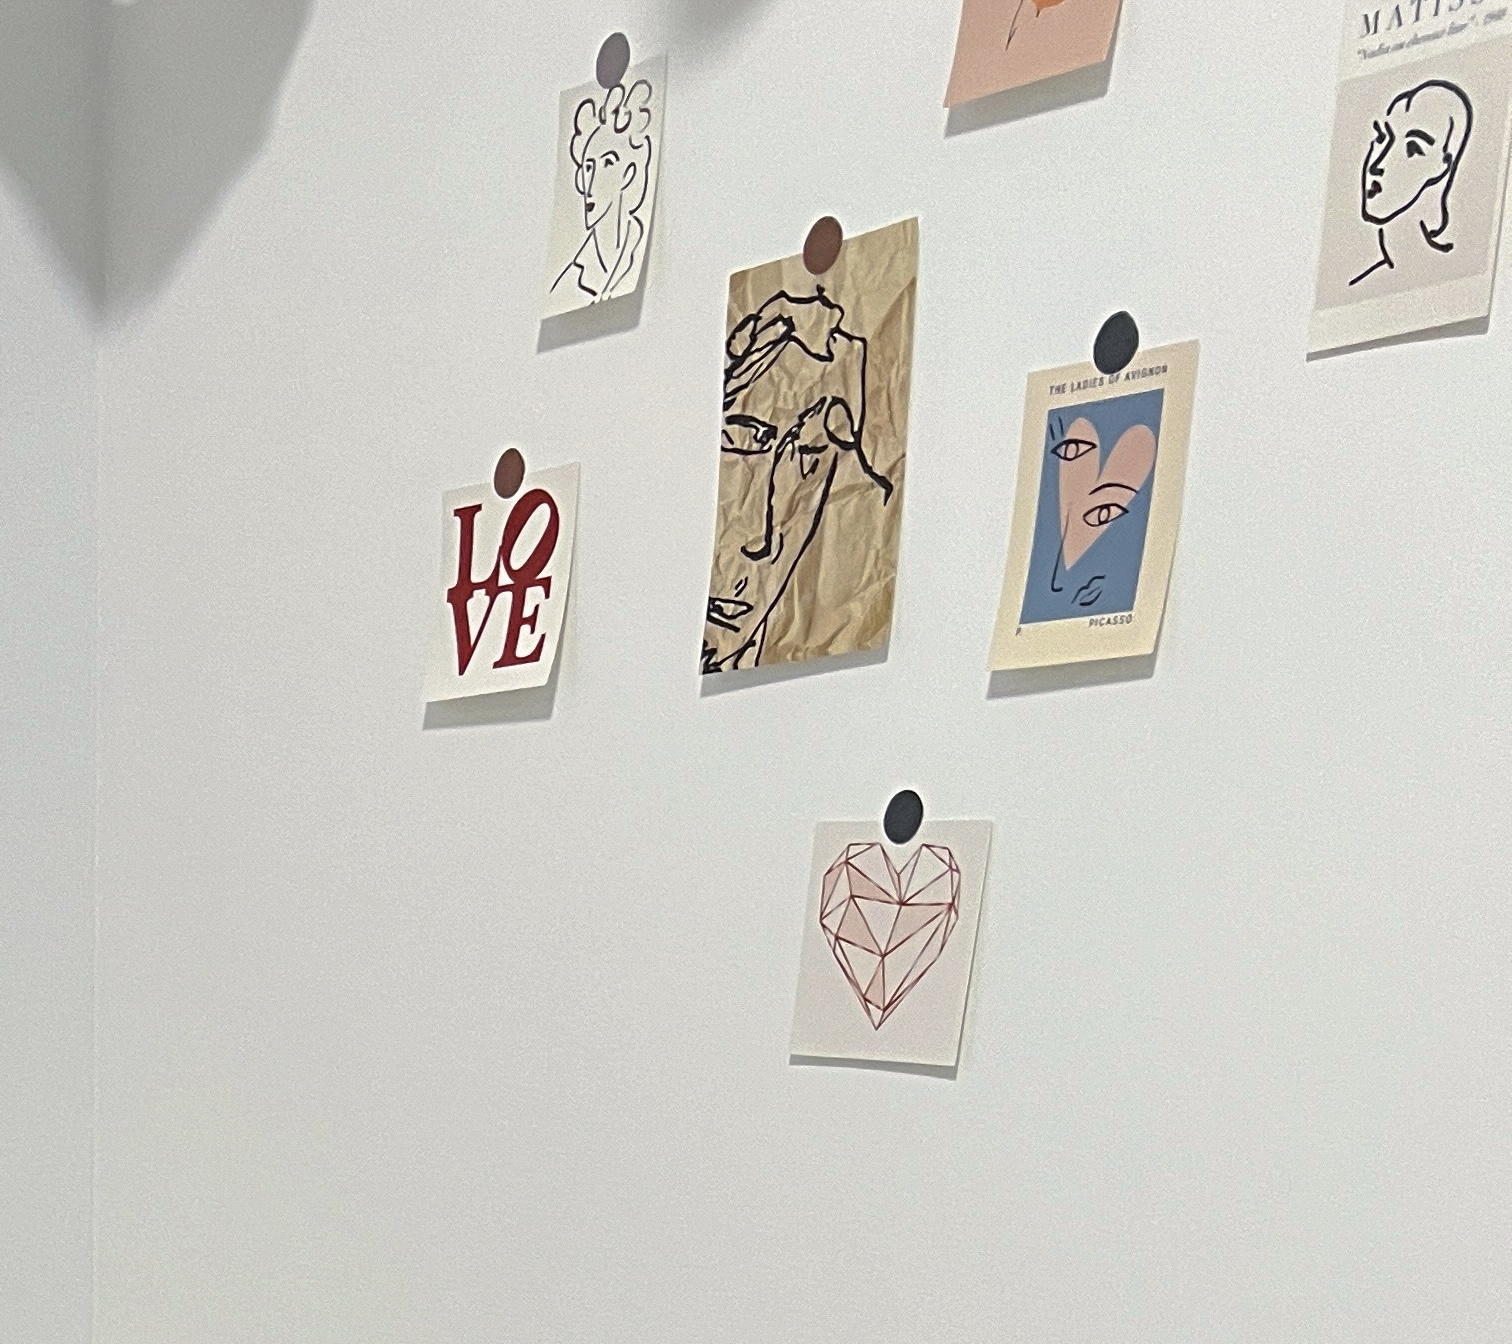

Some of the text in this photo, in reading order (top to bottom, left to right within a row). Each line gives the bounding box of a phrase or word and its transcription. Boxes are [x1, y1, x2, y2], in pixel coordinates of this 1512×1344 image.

[1049, 364, 1168, 396] THE LADIES OF AVIGNON
[1088, 613, 1133, 628] PICASSO
